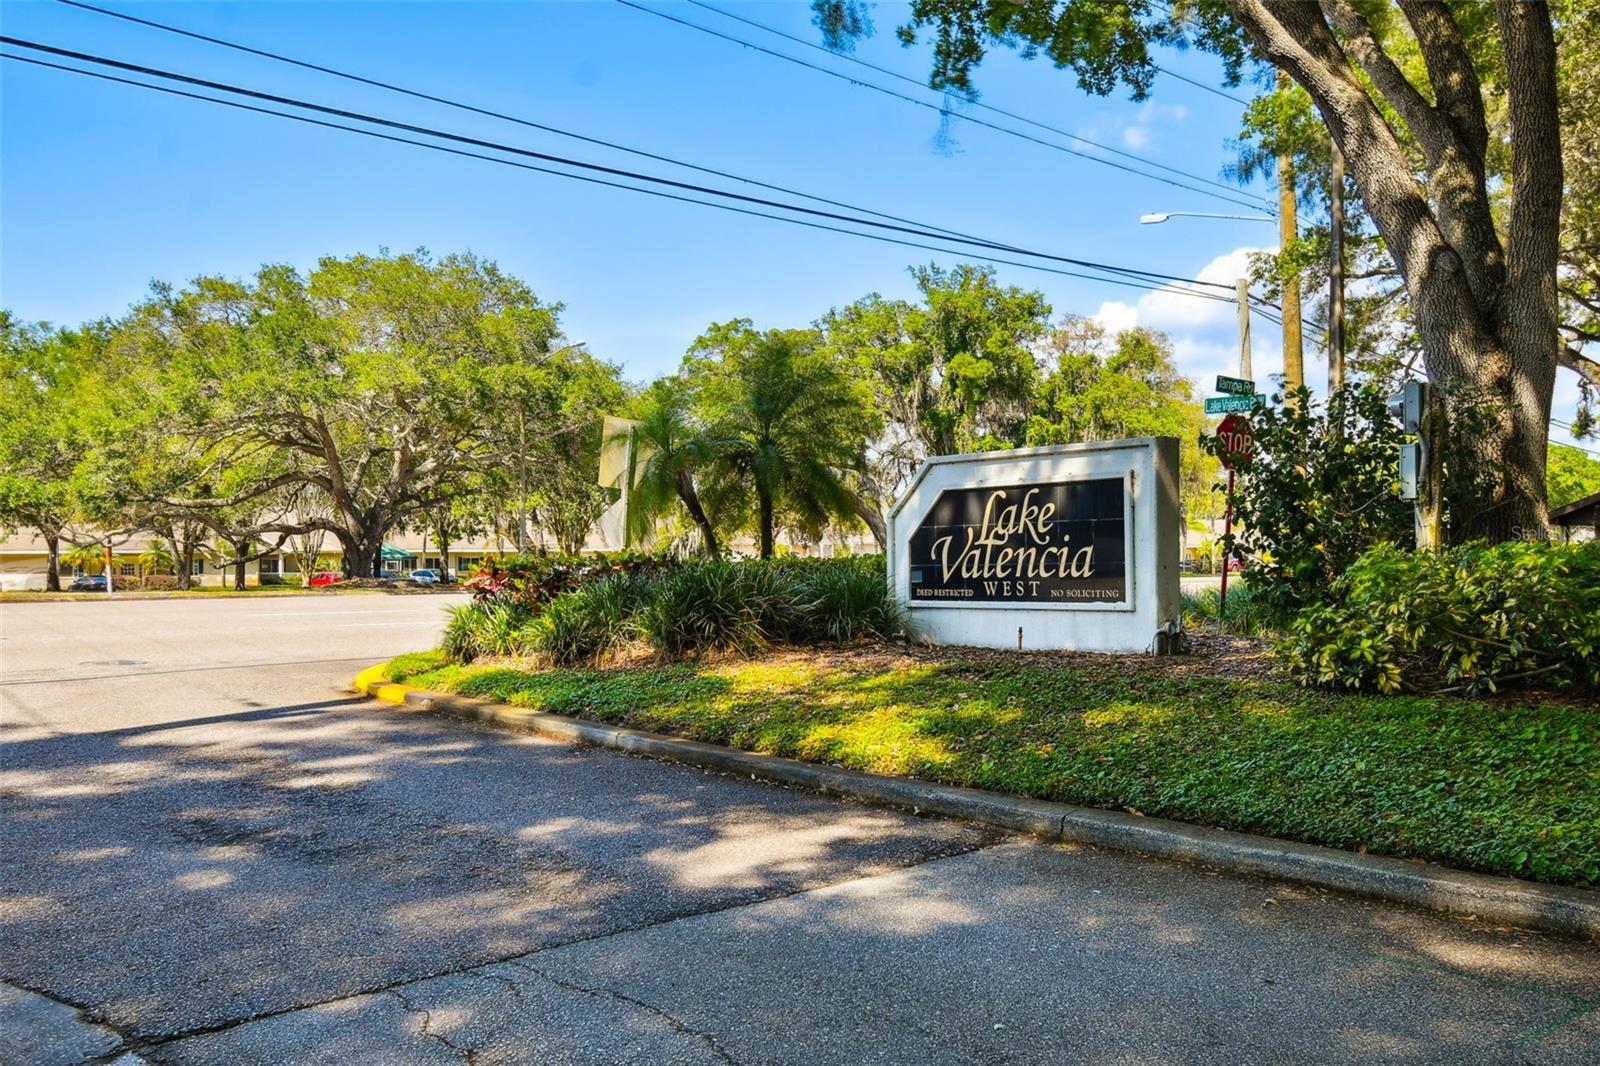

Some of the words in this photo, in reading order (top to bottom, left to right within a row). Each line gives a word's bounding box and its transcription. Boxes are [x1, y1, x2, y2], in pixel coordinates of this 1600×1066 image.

[1218, 378, 1243, 393] Tampa
[1205, 400, 1222, 412] Lake
[1222, 398, 1249, 411] Valencia
[1220, 431, 1252, 455] STOP
[975, 488, 1056, 546] Lake
[931, 526, 1095, 584] Valencia
[916, 588, 933, 597] DEED
[934, 589, 974, 597] RESTRICTED
[983, 580, 1040, 597] WEST
[1050, 589, 1064, 598] NO
[1066, 589, 1119, 598] SOLICITING
